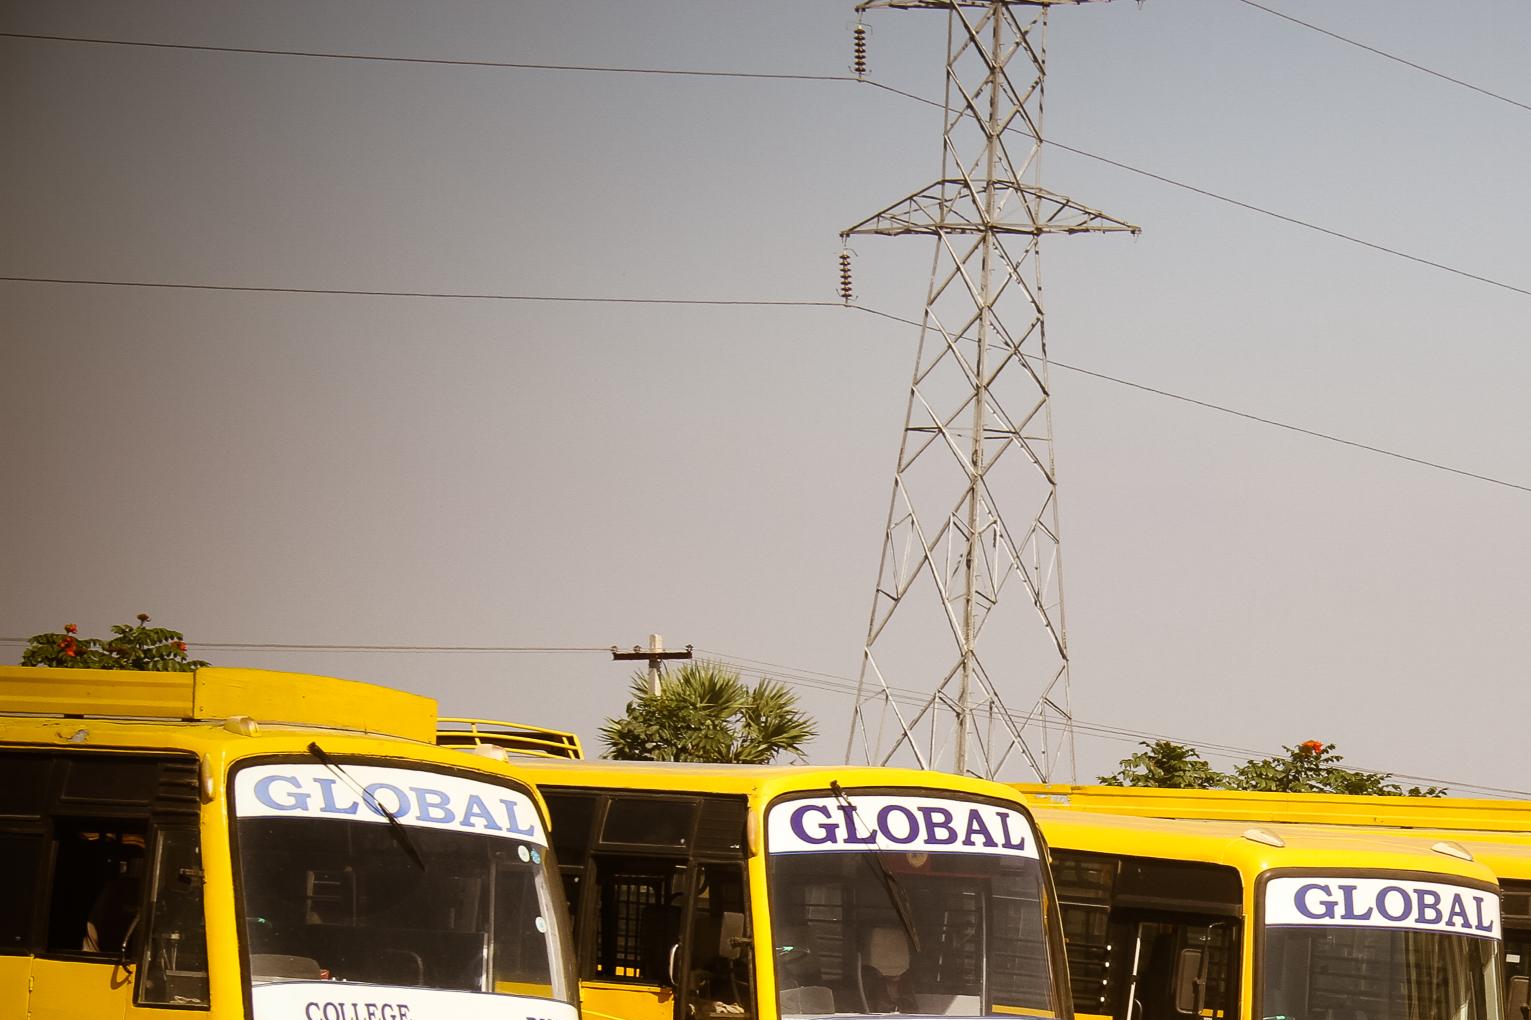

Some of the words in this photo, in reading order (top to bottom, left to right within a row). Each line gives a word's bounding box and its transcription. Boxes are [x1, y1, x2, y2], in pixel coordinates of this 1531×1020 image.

[253, 775, 534, 836] GLOBAL
[790, 804, 1025, 850] GLOBAL
[1293, 883, 1494, 932] GLOBAL
